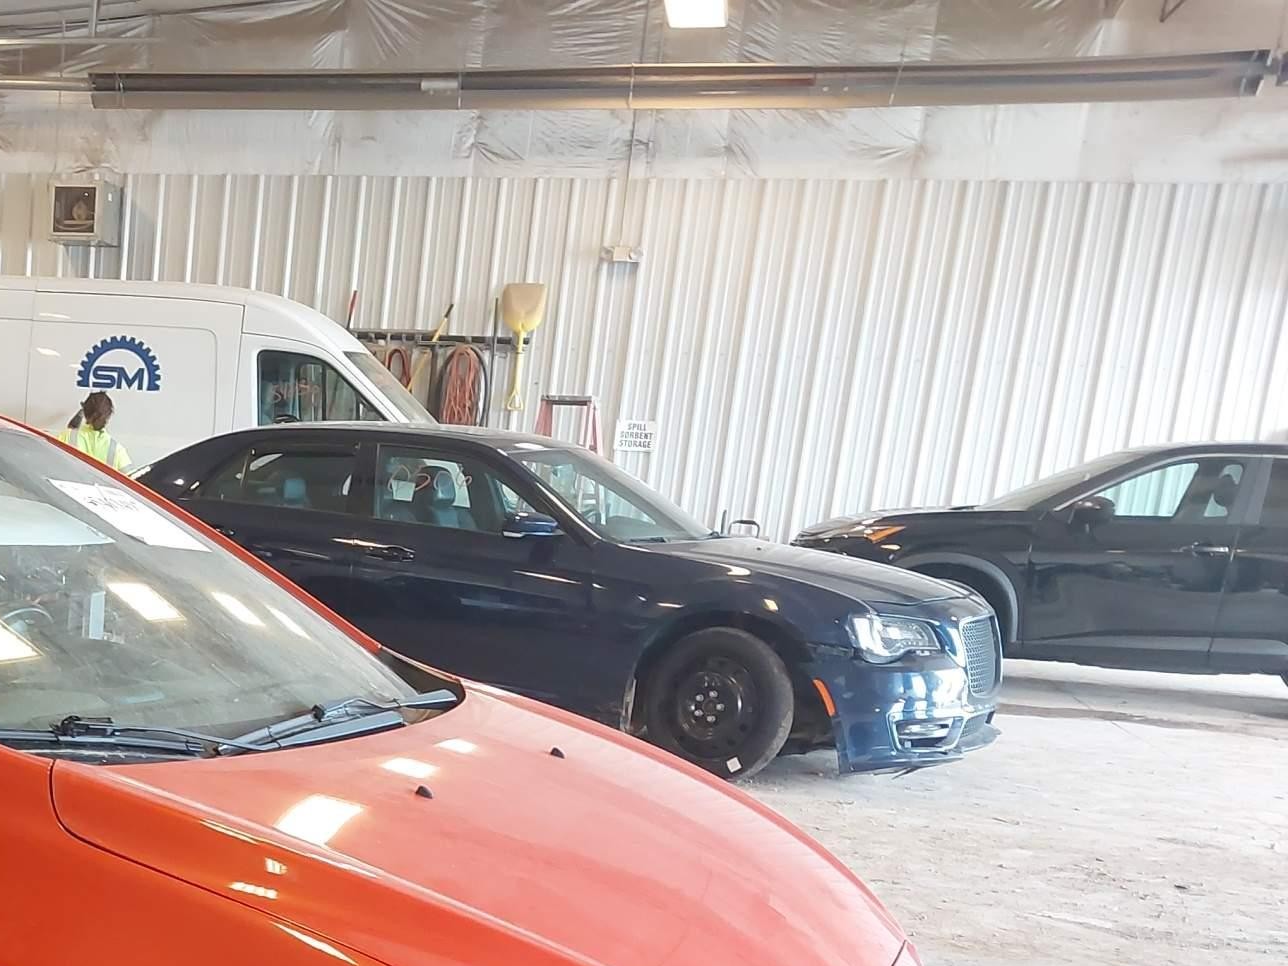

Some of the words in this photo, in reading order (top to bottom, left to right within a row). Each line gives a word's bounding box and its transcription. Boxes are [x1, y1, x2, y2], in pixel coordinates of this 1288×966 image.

[92, 365, 145, 391] SM
[627, 423, 647, 431] SPILL
[620, 431, 653, 440] SORBENT
[619, 439, 652, 448] STORAGE
